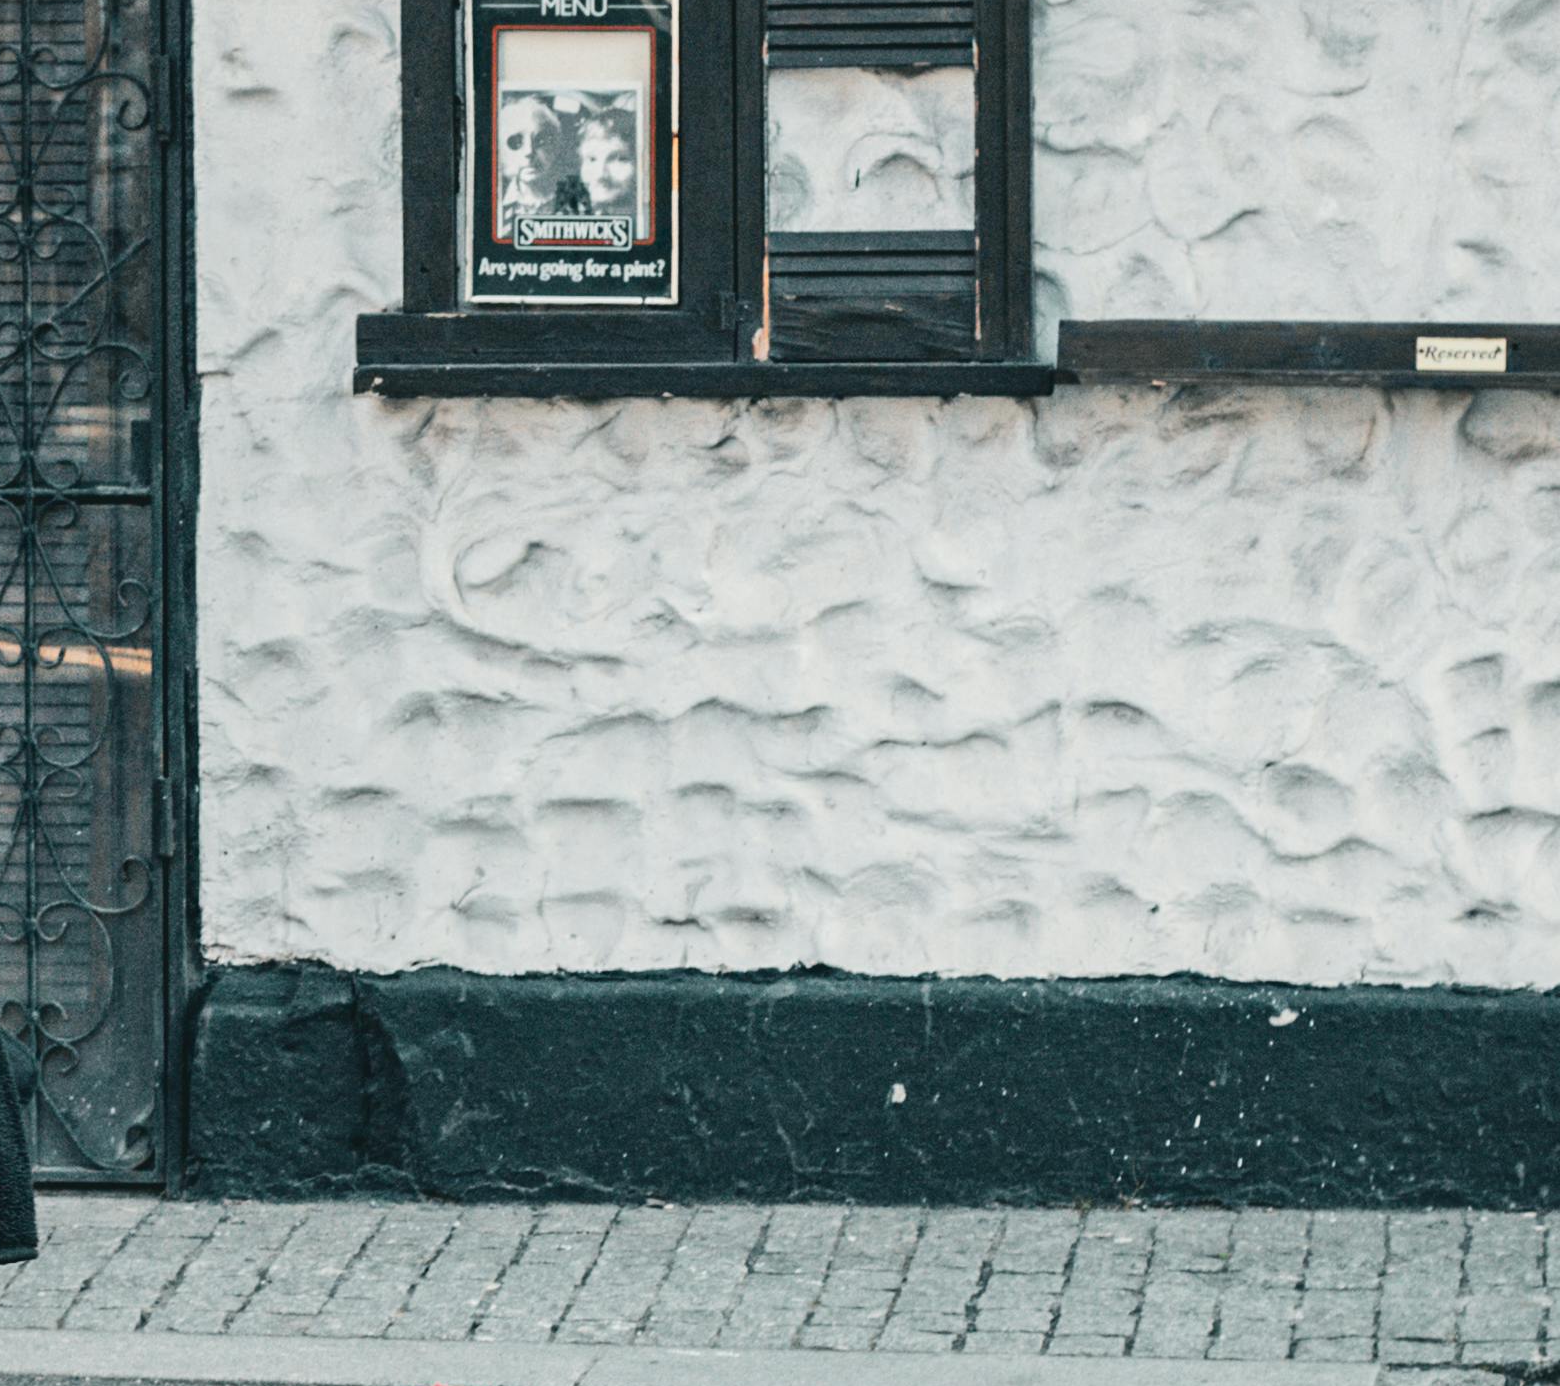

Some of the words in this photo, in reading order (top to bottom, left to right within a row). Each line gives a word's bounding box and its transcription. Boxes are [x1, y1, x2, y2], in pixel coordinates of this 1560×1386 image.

[478, 257, 507, 276] Are
[508, 262, 538, 282] you
[539, 259, 584, 283] going
[585, 258, 610, 277] for
[610, 263, 622, 277] a
[623, 259, 666, 283] pint?
[1424, 345, 1499, 363] Reserved
